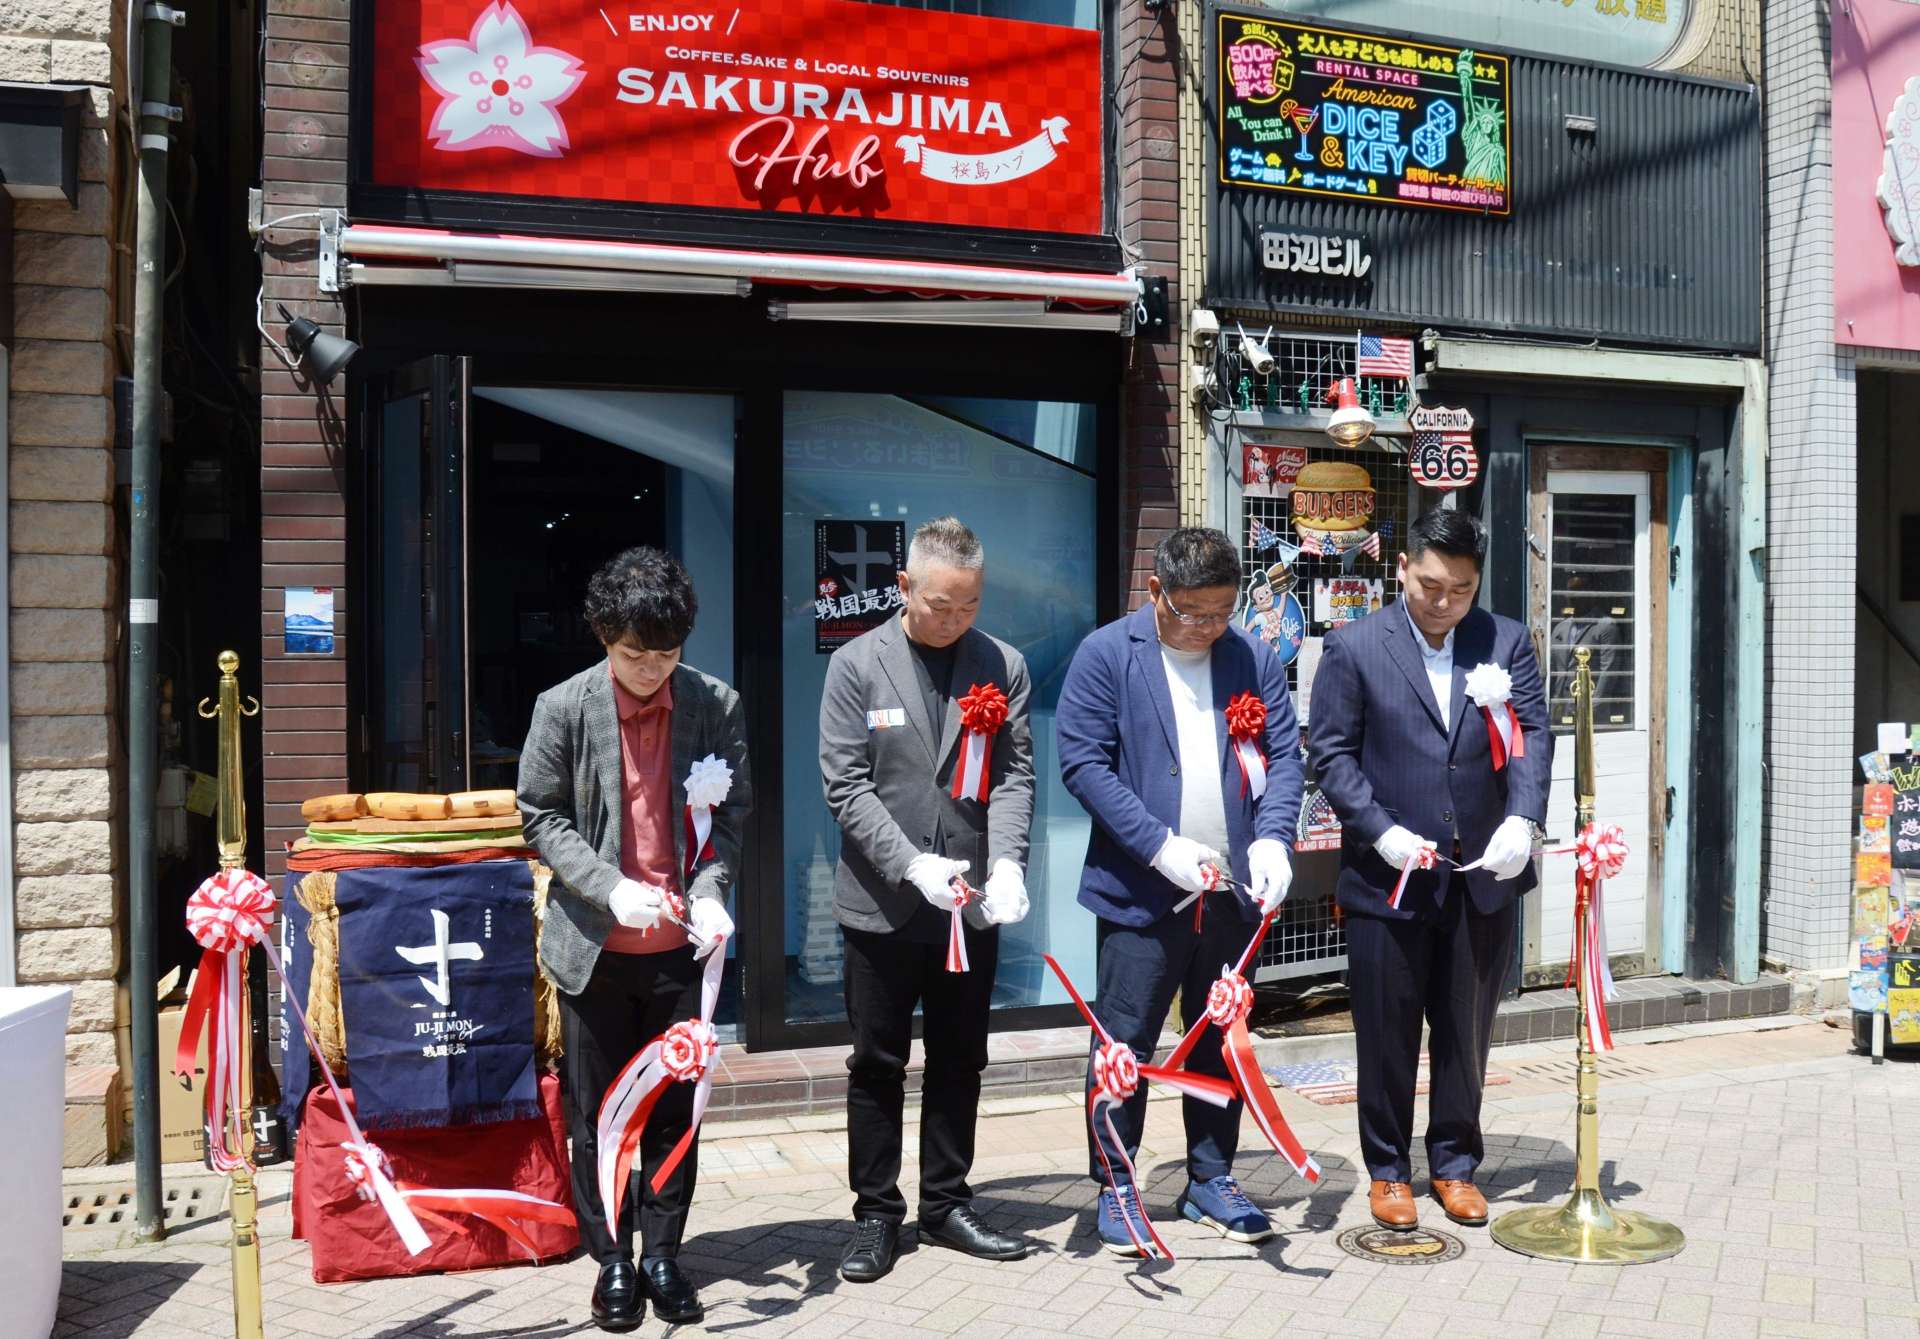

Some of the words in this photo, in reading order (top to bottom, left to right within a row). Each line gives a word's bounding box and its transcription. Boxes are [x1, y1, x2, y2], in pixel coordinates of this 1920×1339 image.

[629, 15, 714, 32] ENJOY
[794, 58, 807, 71] &
[1298, 33, 1454, 73] 大人も子どもも楽しめる
[1316, 60, 1369, 78] RENTAL
[1376, 68, 1419, 85] SPACE
[616, 67, 1011, 138] SAKURAJIMA
[1322, 78, 1416, 110] American
[1227, 106, 1242, 119] All
[1239, 118, 1261, 131] You
[1263, 118, 1283, 128] can
[1323, 102, 1400, 143] DICE
[1253, 130, 1283, 142] Drink
[728, 116, 884, 191] Hub
[951, 149, 1025, 181] 桜島ハブ
[1320, 136, 1344, 168] &
[1347, 139, 1408, 176] KEY
[1261, 231, 1372, 278] 田辺ビル
[1416, 412, 1468, 427] CALIFORNIA
[1420, 443, 1469, 481] 66
[1293, 491, 1375, 520] BURGERS
[815, 584, 907, 621] 戦国最強
[1299, 840, 1317, 849] LAND
[1319, 840, 1327, 849] OF
[414, 1022, 444, 1037] JU-JI
[446, 1019, 473, 1033] MON
